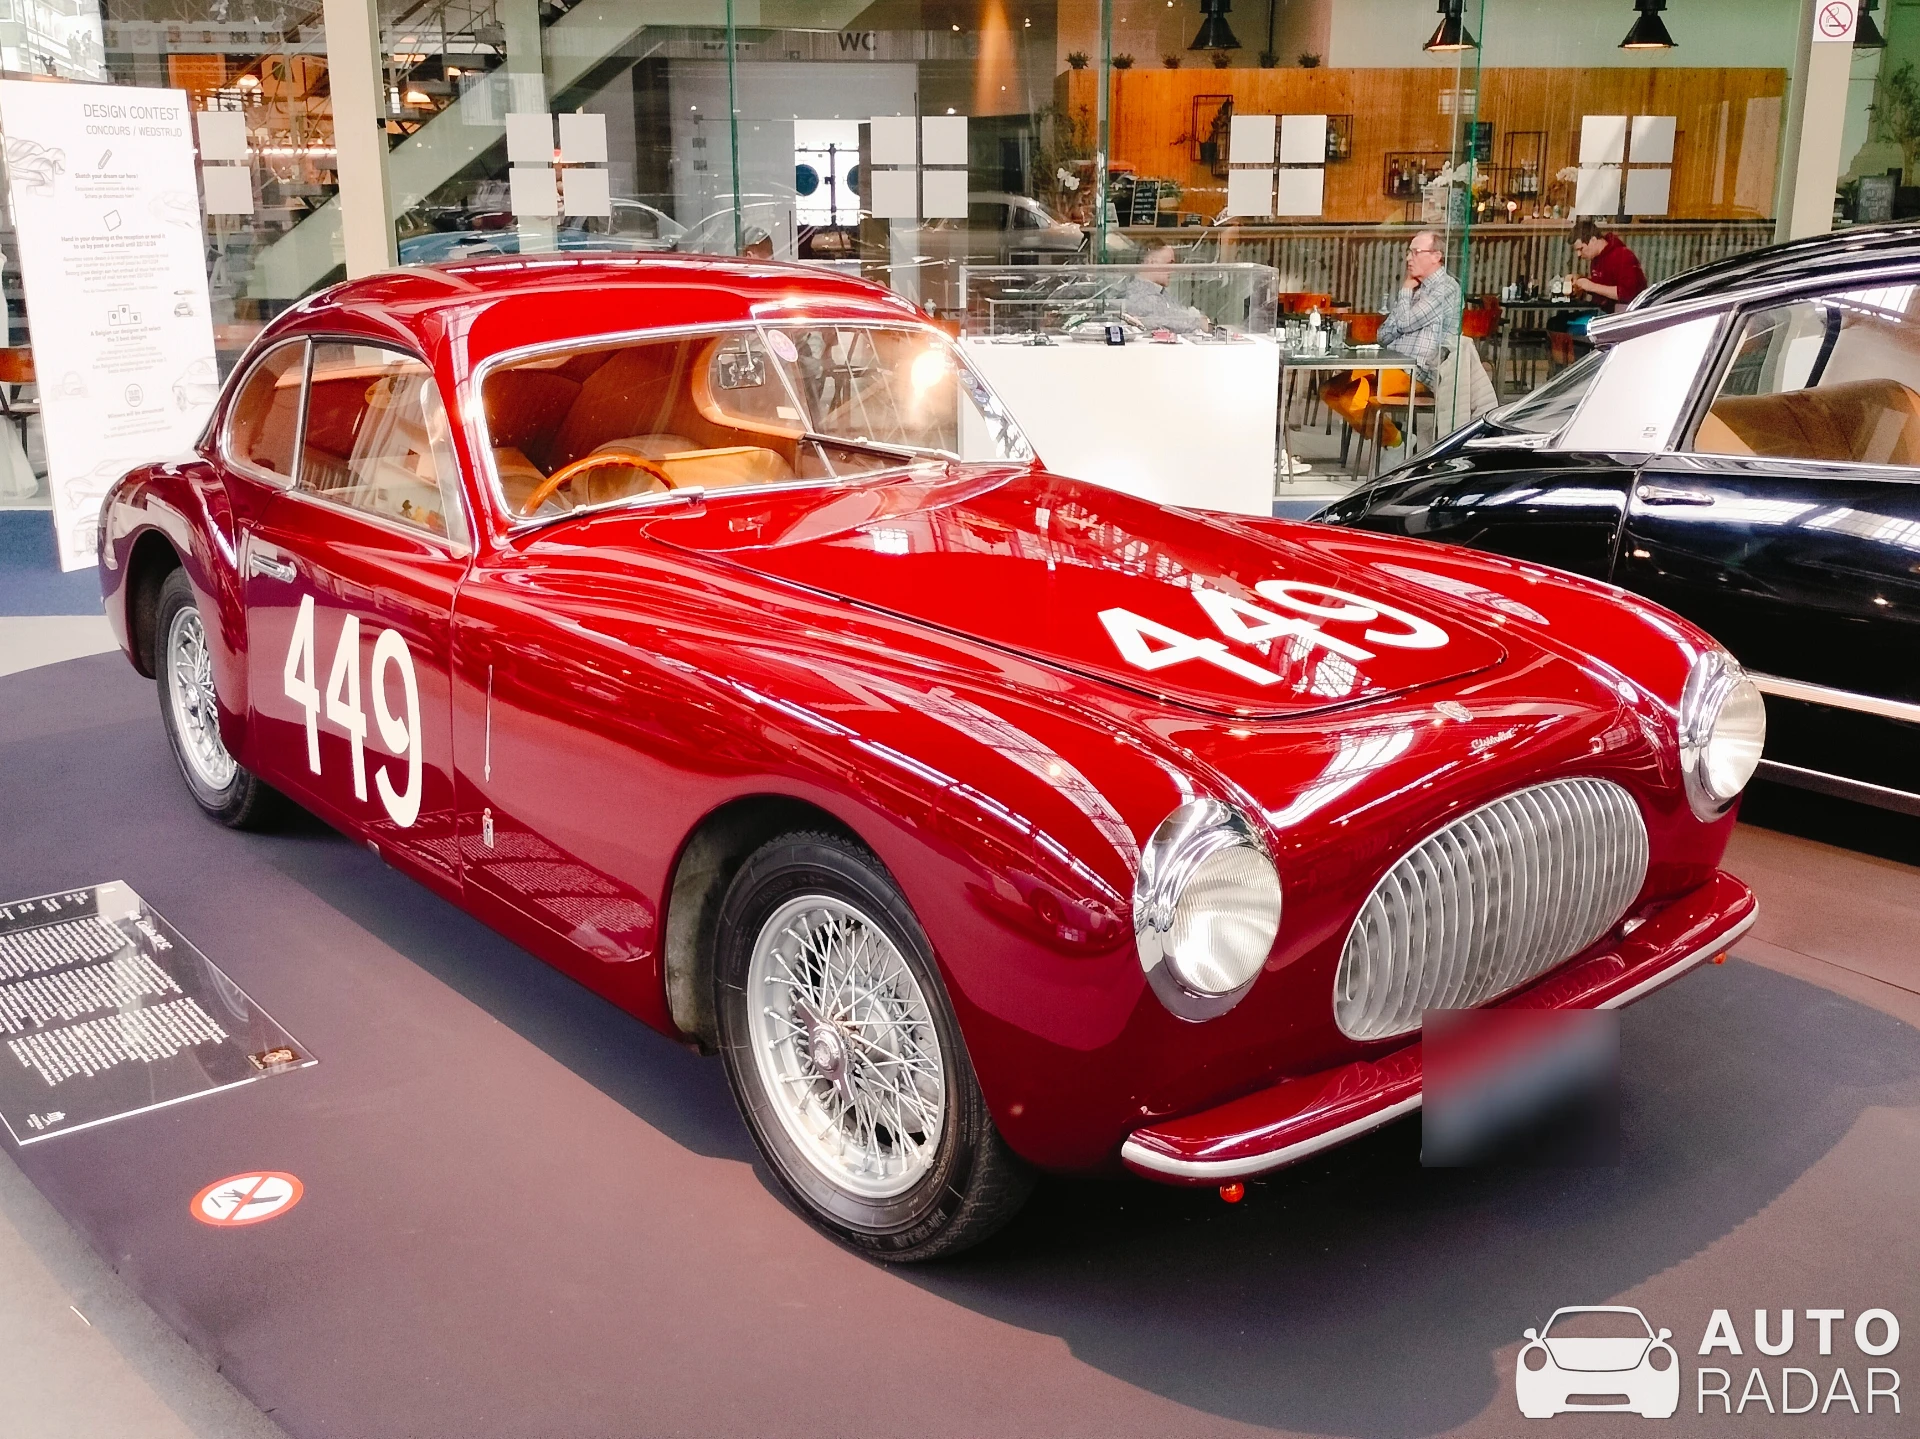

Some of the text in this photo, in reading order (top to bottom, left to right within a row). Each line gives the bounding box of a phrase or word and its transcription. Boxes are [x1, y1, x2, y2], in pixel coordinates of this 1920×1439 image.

[837, 32, 877, 51] WC
[83, 103, 180, 121] DESIGN CONTEST
[85, 124, 131, 136] CONCOURS
[138, 126, 183, 138] WEDSTRIJD
[1097, 579, 1450, 686] 449
[284, 593, 423, 828] 449
